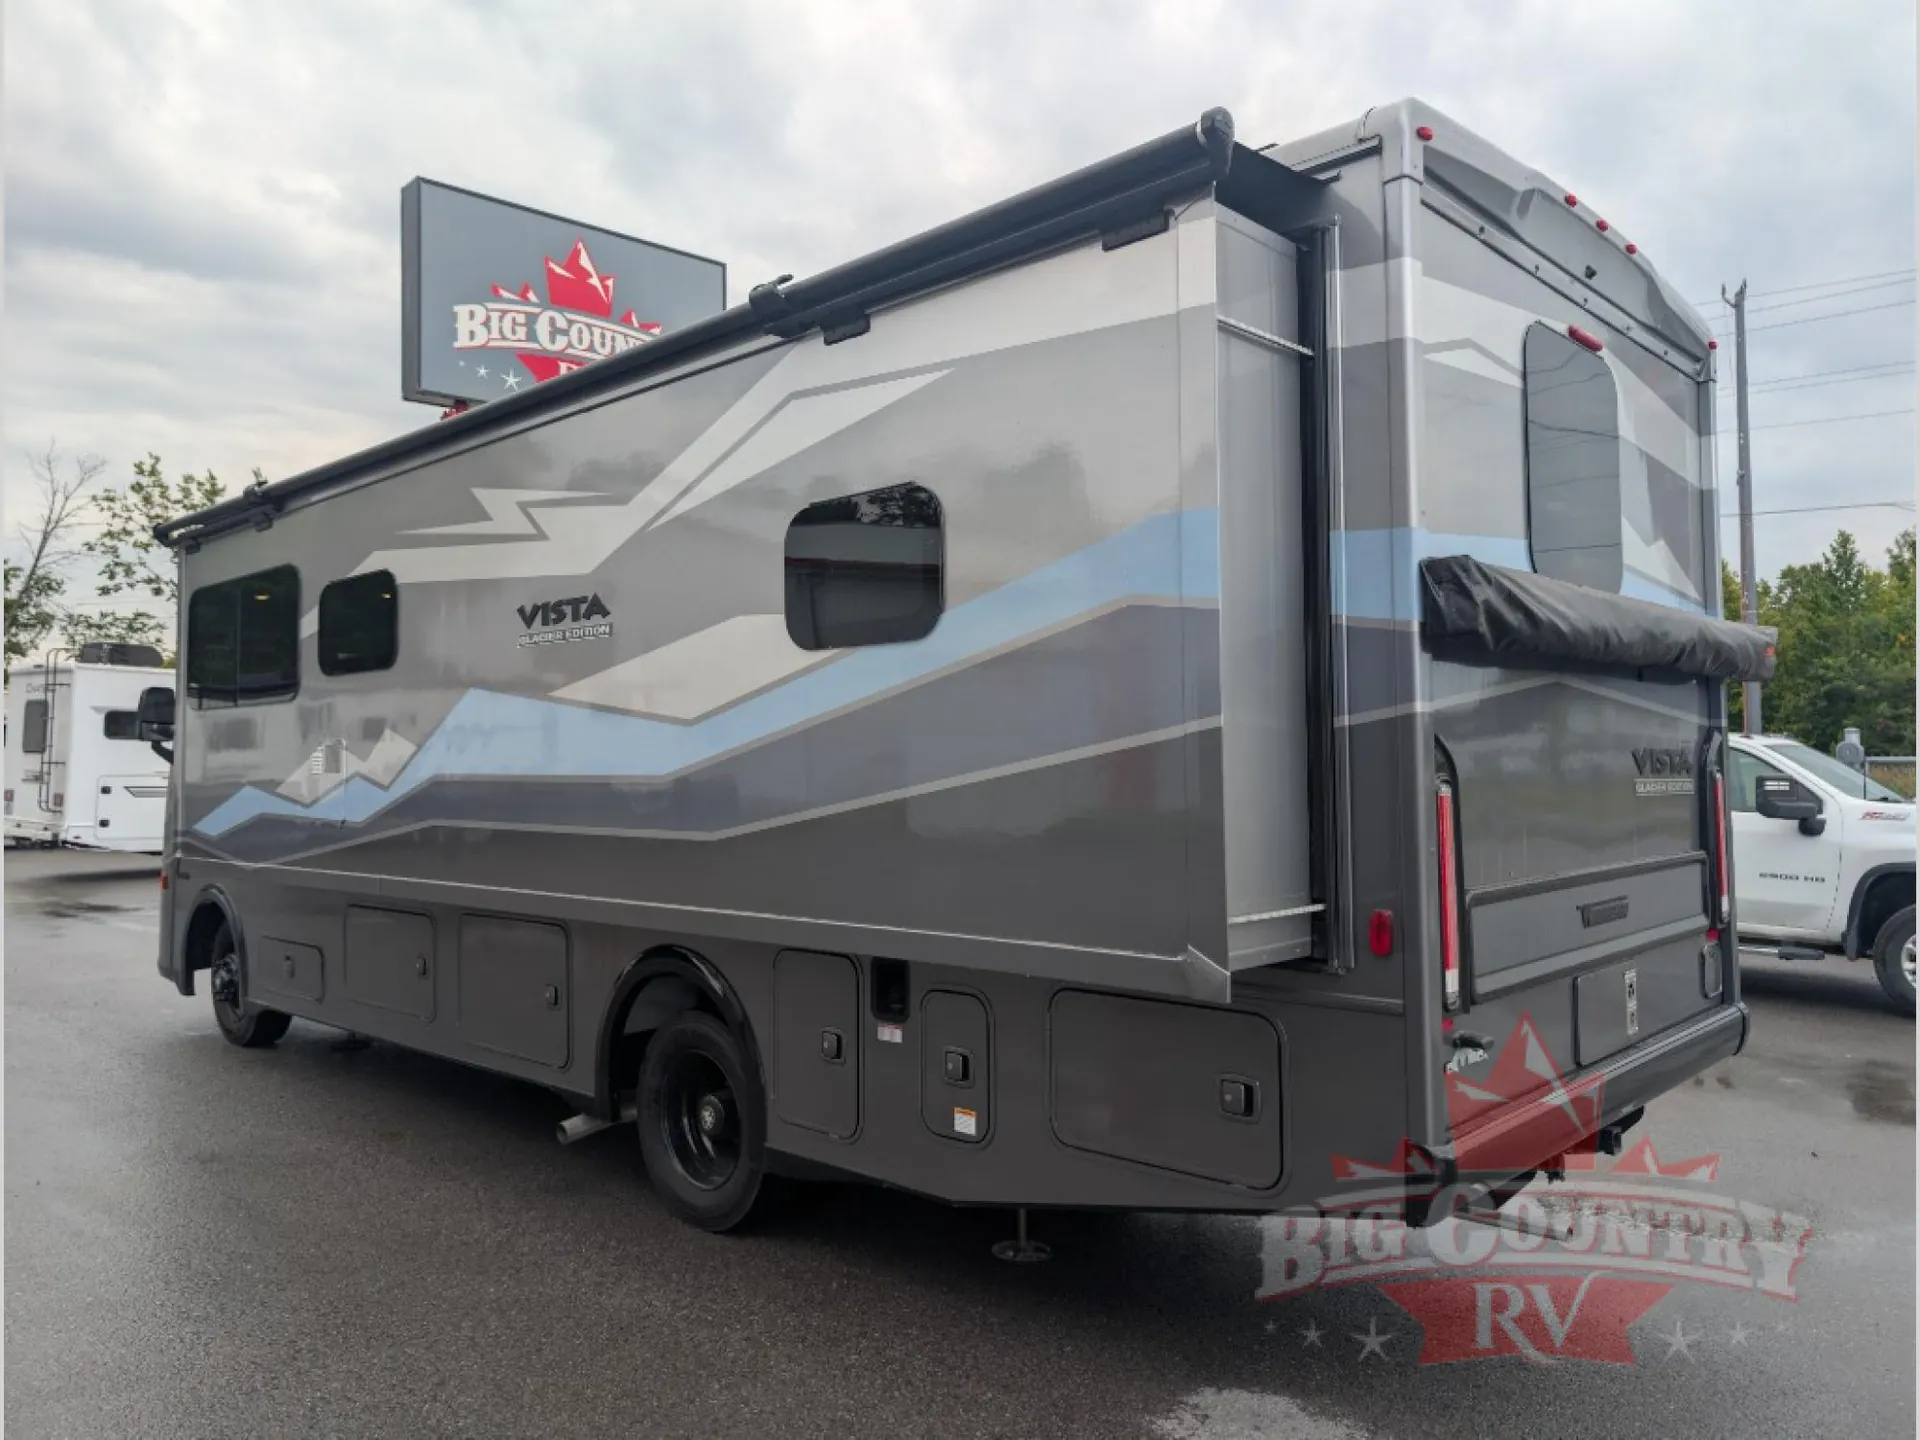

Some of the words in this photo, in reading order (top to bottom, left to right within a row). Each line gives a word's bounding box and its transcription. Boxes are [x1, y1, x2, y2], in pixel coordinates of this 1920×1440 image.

[453, 303, 528, 350] BIG
[517, 592, 611, 629] VISTA
[1631, 747, 1693, 777] VISTA
